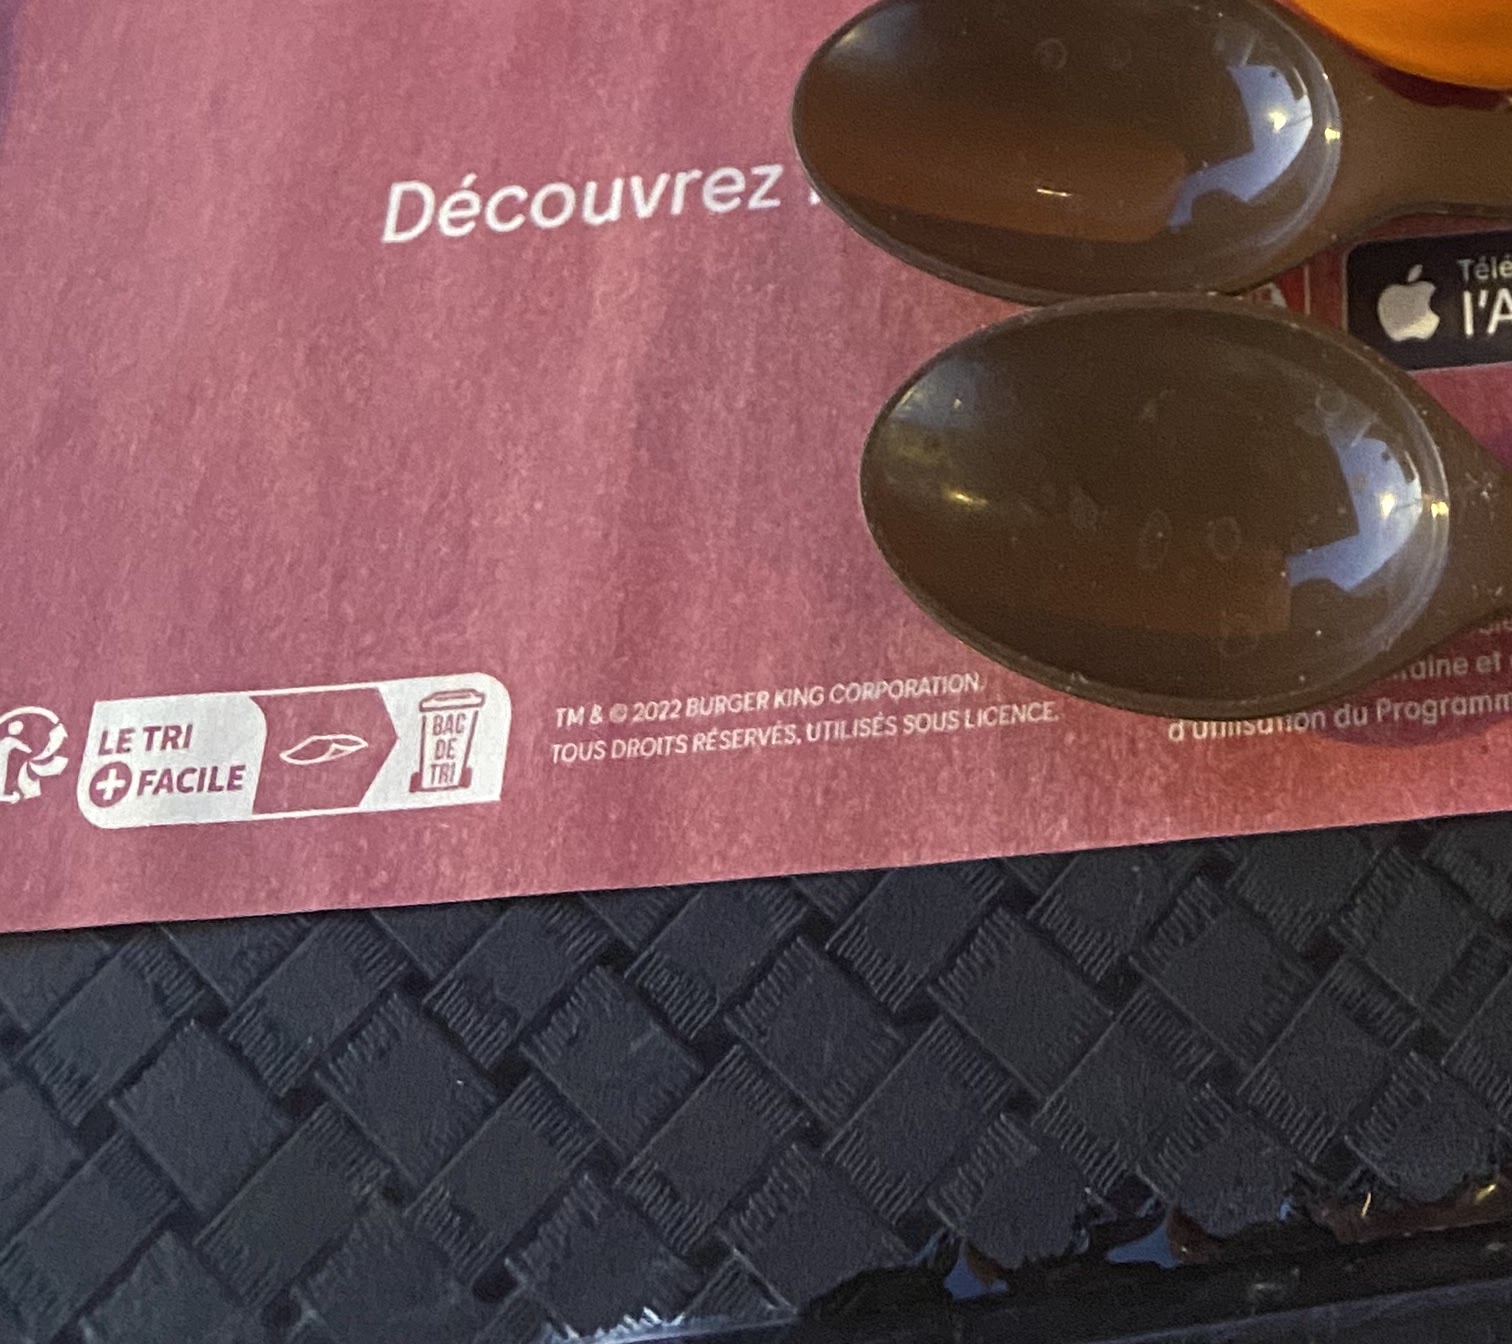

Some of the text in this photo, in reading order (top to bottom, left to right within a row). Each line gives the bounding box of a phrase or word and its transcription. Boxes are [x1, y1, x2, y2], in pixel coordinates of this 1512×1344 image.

[381, 164, 784, 244] Découvrez
[1475, 649, 1502, 673] et
[556, 706, 585, 728] TM
[590, 703, 603, 724] &
[632, 698, 683, 723] 2022
[685, 689, 769, 718] BURGER
[773, 684, 825, 710] KING
[1333, 703, 1368, 728] du
[432, 712, 467, 737] BAC
[552, 739, 606, 764] TOUS
[611, 732, 688, 760] DROITS
[806, 711, 898, 743] UTILISÉS
[903, 708, 960, 736] SOUS
[98, 723, 193, 757] LE TRI
[434, 737, 457, 761] DE
[137, 764, 246, 797] FACILE
[430, 761, 456, 785] TRI
